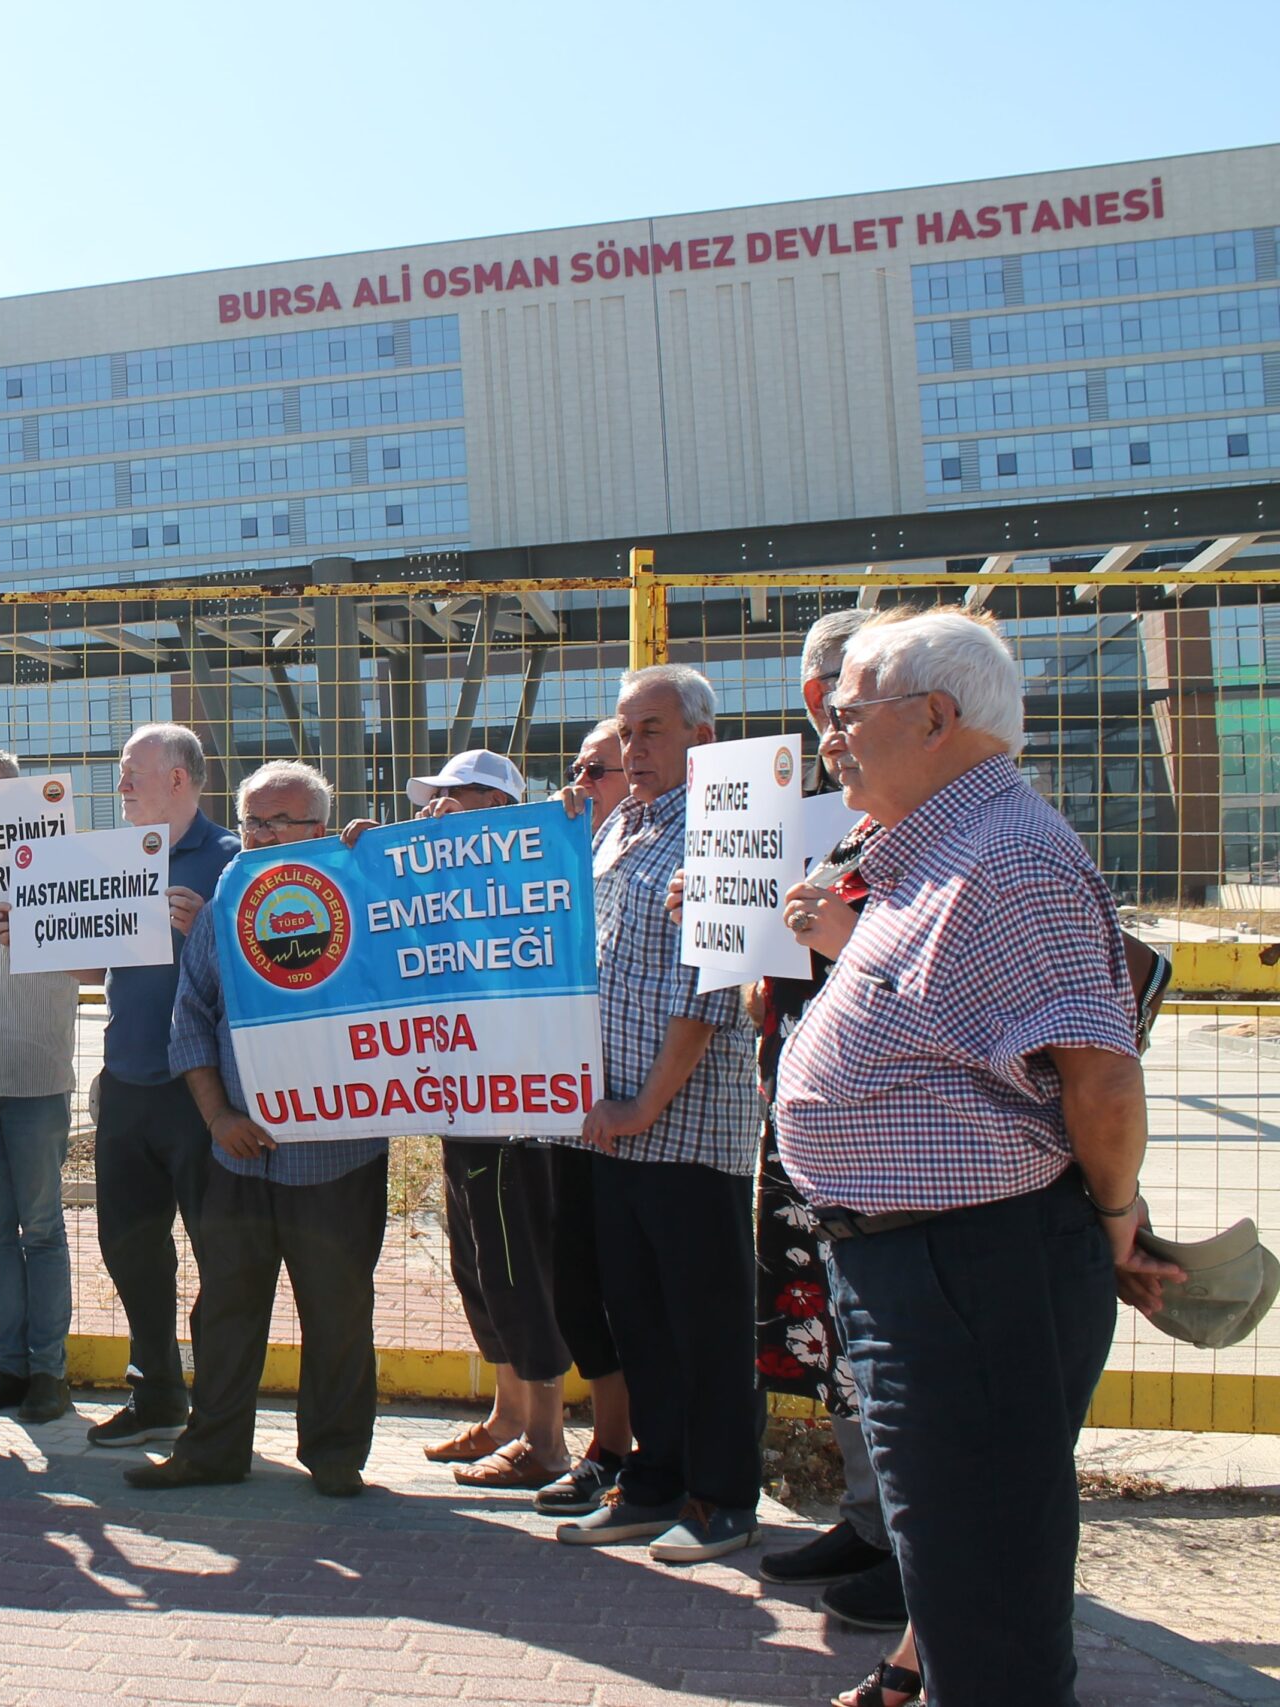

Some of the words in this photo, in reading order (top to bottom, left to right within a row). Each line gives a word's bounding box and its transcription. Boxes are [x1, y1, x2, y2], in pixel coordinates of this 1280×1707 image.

[218, 281, 341, 324] BURSA
[352, 264, 412, 308] ALİ
[423, 256, 559, 299] OSMAN
[570, 236, 736, 283] SÖNMEZ
[747, 217, 903, 264] DEVLET
[917, 177, 1164, 246] HASTANESİ
[704, 776, 750, 819] ÇEKİRGE
[384, 825, 544, 878] TÜRKİYE
[714, 822, 783, 860] HASTANESİ
[16, 867, 160, 908] HASTANELERİMİZ
[249, 868, 322, 906] EMEKLİLER
[366, 878, 572, 933] EMEKLİLER
[714, 870, 779, 909] REZİDANS
[34, 908, 138, 948] ÇÜRÜMESİN!
[243, 909, 272, 973] TÜRKİYE
[278, 917, 305, 928] TÜED
[321, 888, 344, 961] DERNEĞİ
[694, 920, 745, 955] OLMASIN
[396, 926, 555, 980] DERNEĞİ
[287, 972, 312, 983] 1970
[347, 1013, 478, 1061] BURSA
